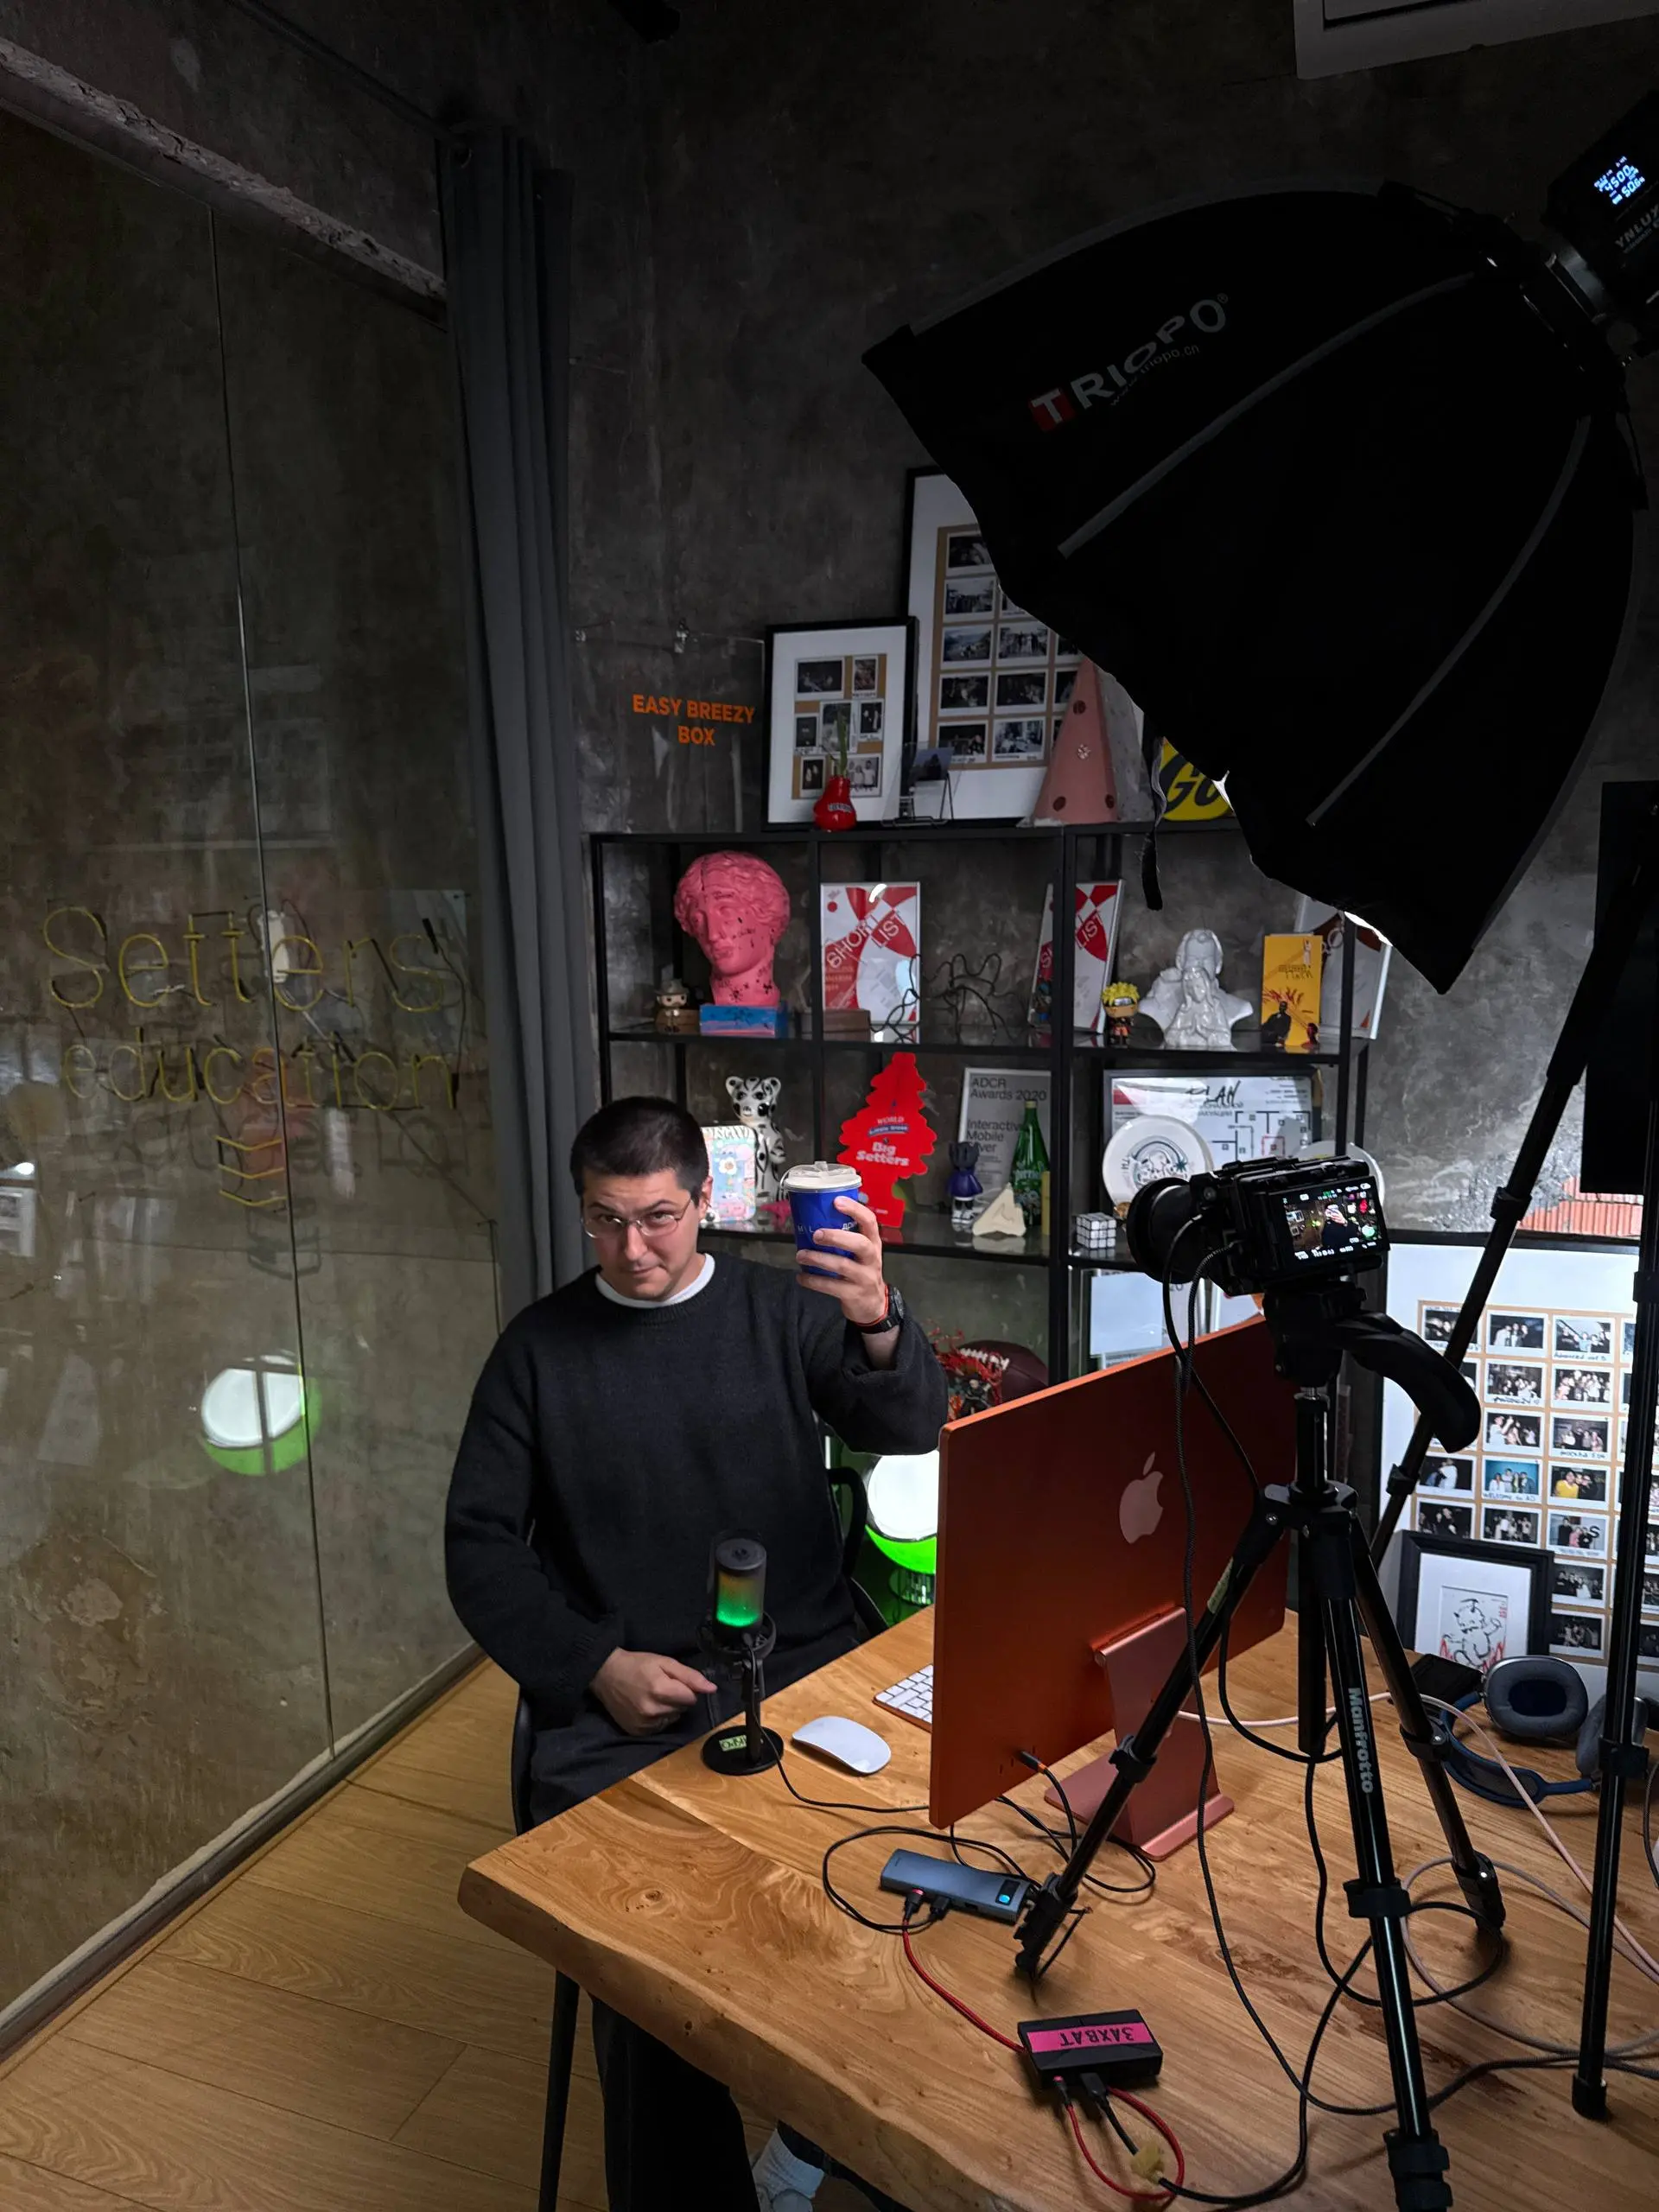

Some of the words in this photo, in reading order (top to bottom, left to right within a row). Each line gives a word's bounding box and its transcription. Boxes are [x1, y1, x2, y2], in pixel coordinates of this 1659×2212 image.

[1031, 299, 1226, 425] TRIOPO
[632, 693, 683, 716] EASY
[686, 700, 755, 725] BREEZY
[677, 725, 716, 747] BOX
[871, 911, 906, 948] LIST
[41, 906, 445, 1013] Setters
[64, 1027, 459, 1110] education
[972, 1077, 1007, 1089] ADCR
[970, 1089, 1014, 1100] Awards
[1015, 1090, 1047, 1102] 2020
[967, 1119, 1019, 1132] Interactiv
[967, 1130, 1004, 1141] Mobile
[856, 1150, 910, 1166] Setters
[873, 1141, 896, 1156] Big
[1348, 1688, 1374, 1794] Manfrotto
[1059, 2027, 1135, 2046] ЗАХВАТ
